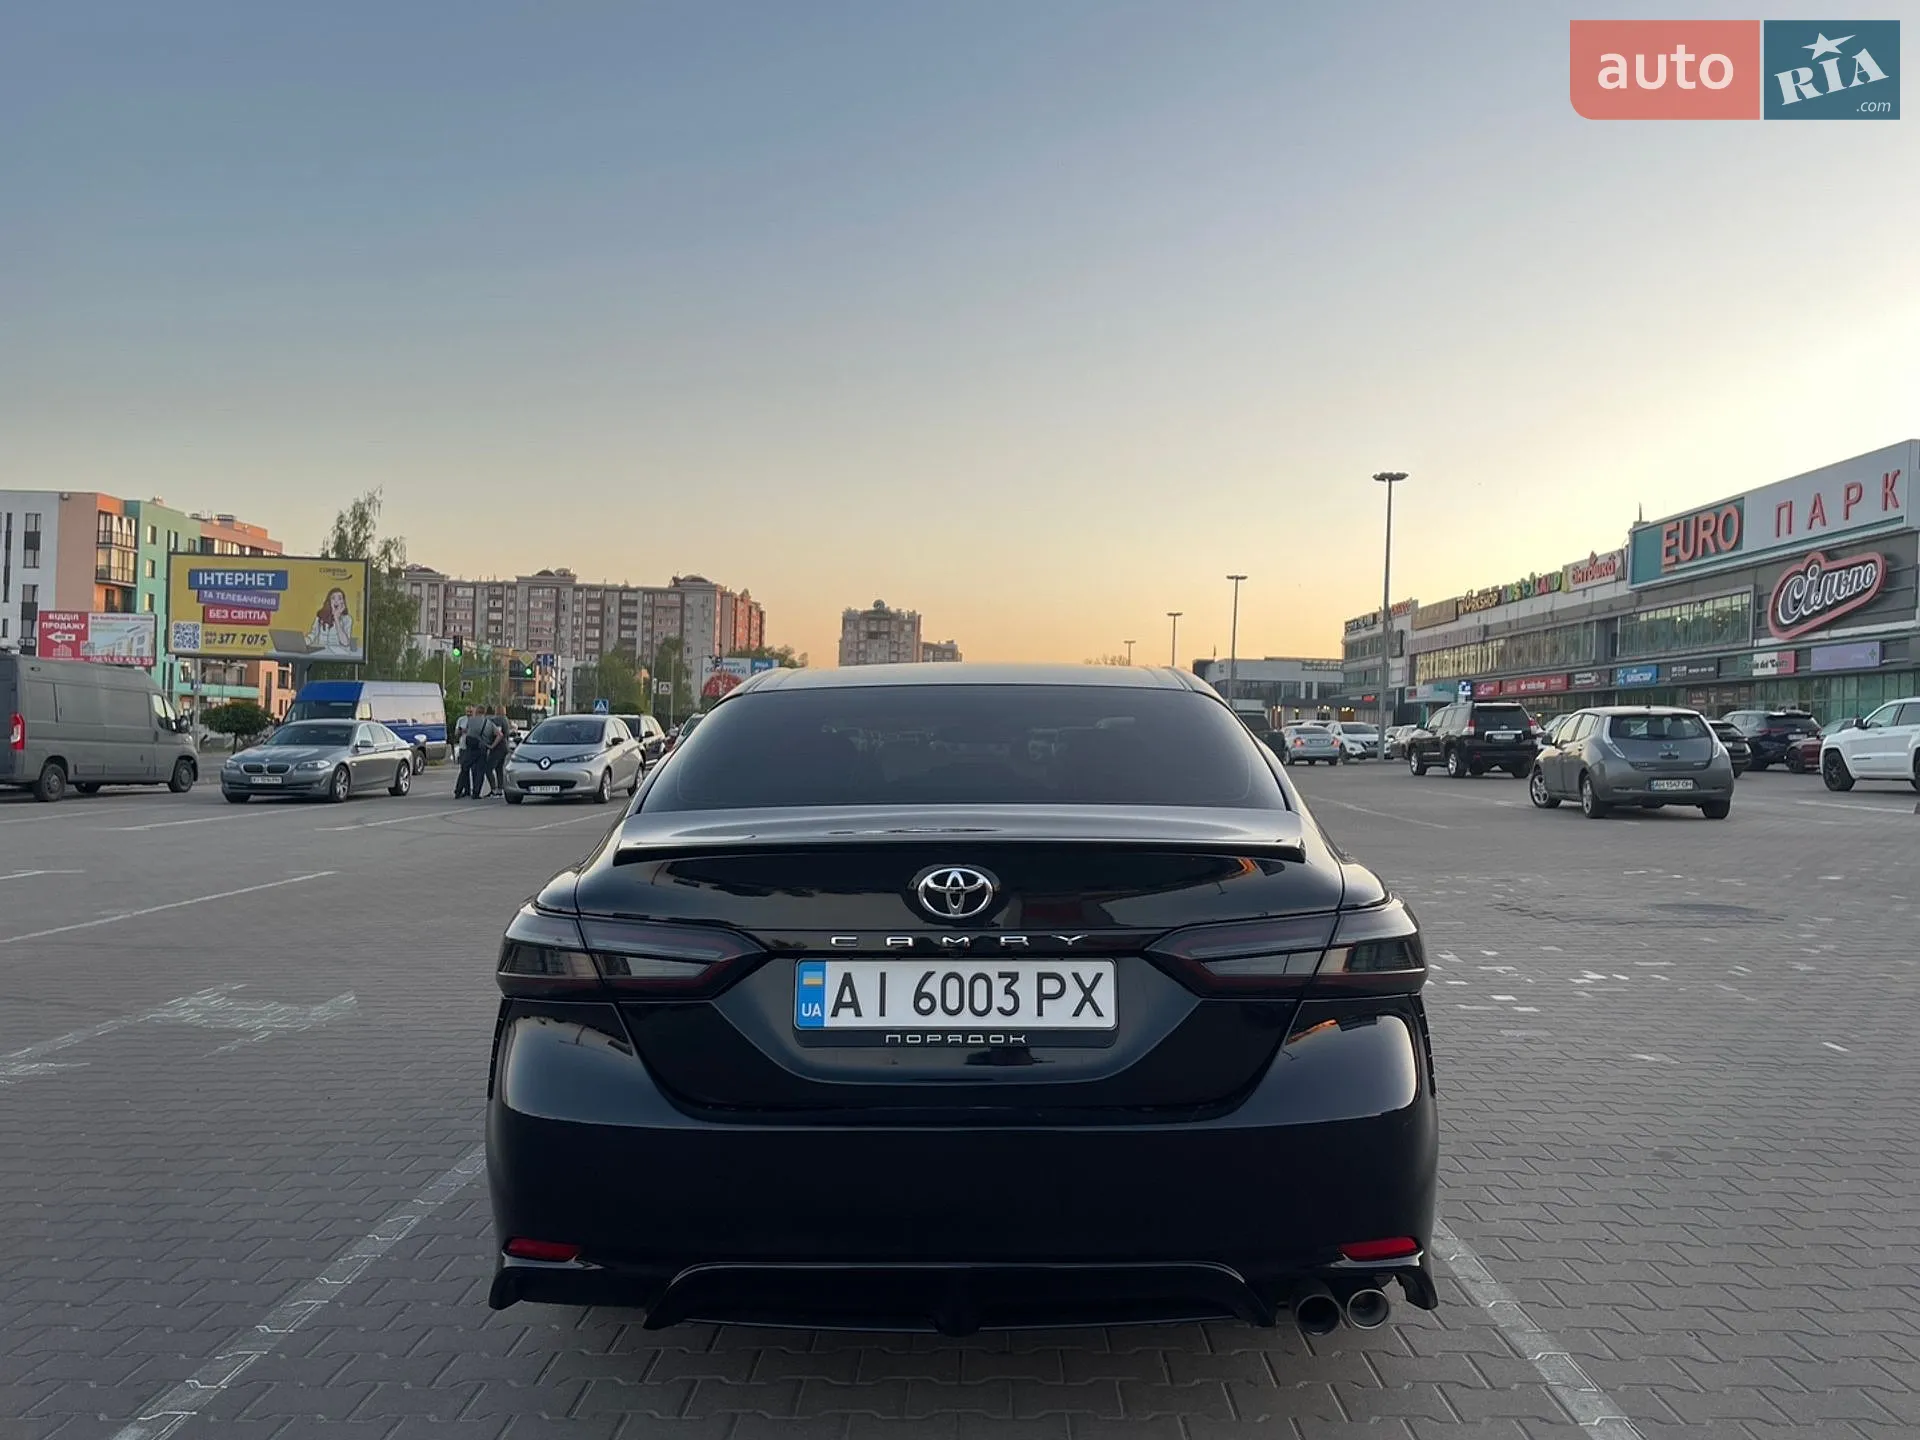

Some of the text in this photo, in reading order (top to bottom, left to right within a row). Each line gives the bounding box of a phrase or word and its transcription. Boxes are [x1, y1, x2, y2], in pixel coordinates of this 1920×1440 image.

[1661, 469, 1902, 566] EURO ПАРК
[198, 571, 275, 587] ІНТЕРНЕТ
[203, 590, 214, 599] ТА
[1777, 562, 1877, 625] Сільпо
[48, 613, 79, 621] ВІДДІЛ
[208, 609, 268, 621] БЕЗ СВІТЛА
[42, 622, 85, 630] ПРОДАЖУ
[217, 633, 237, 645] 377
[830, 934, 1089, 948] CAMRY
[830, 970, 1105, 1018] AI 6003 PX
[801, 1002, 822, 1017] UA
[885, 1034, 1027, 1044] ПОРЯДОК
